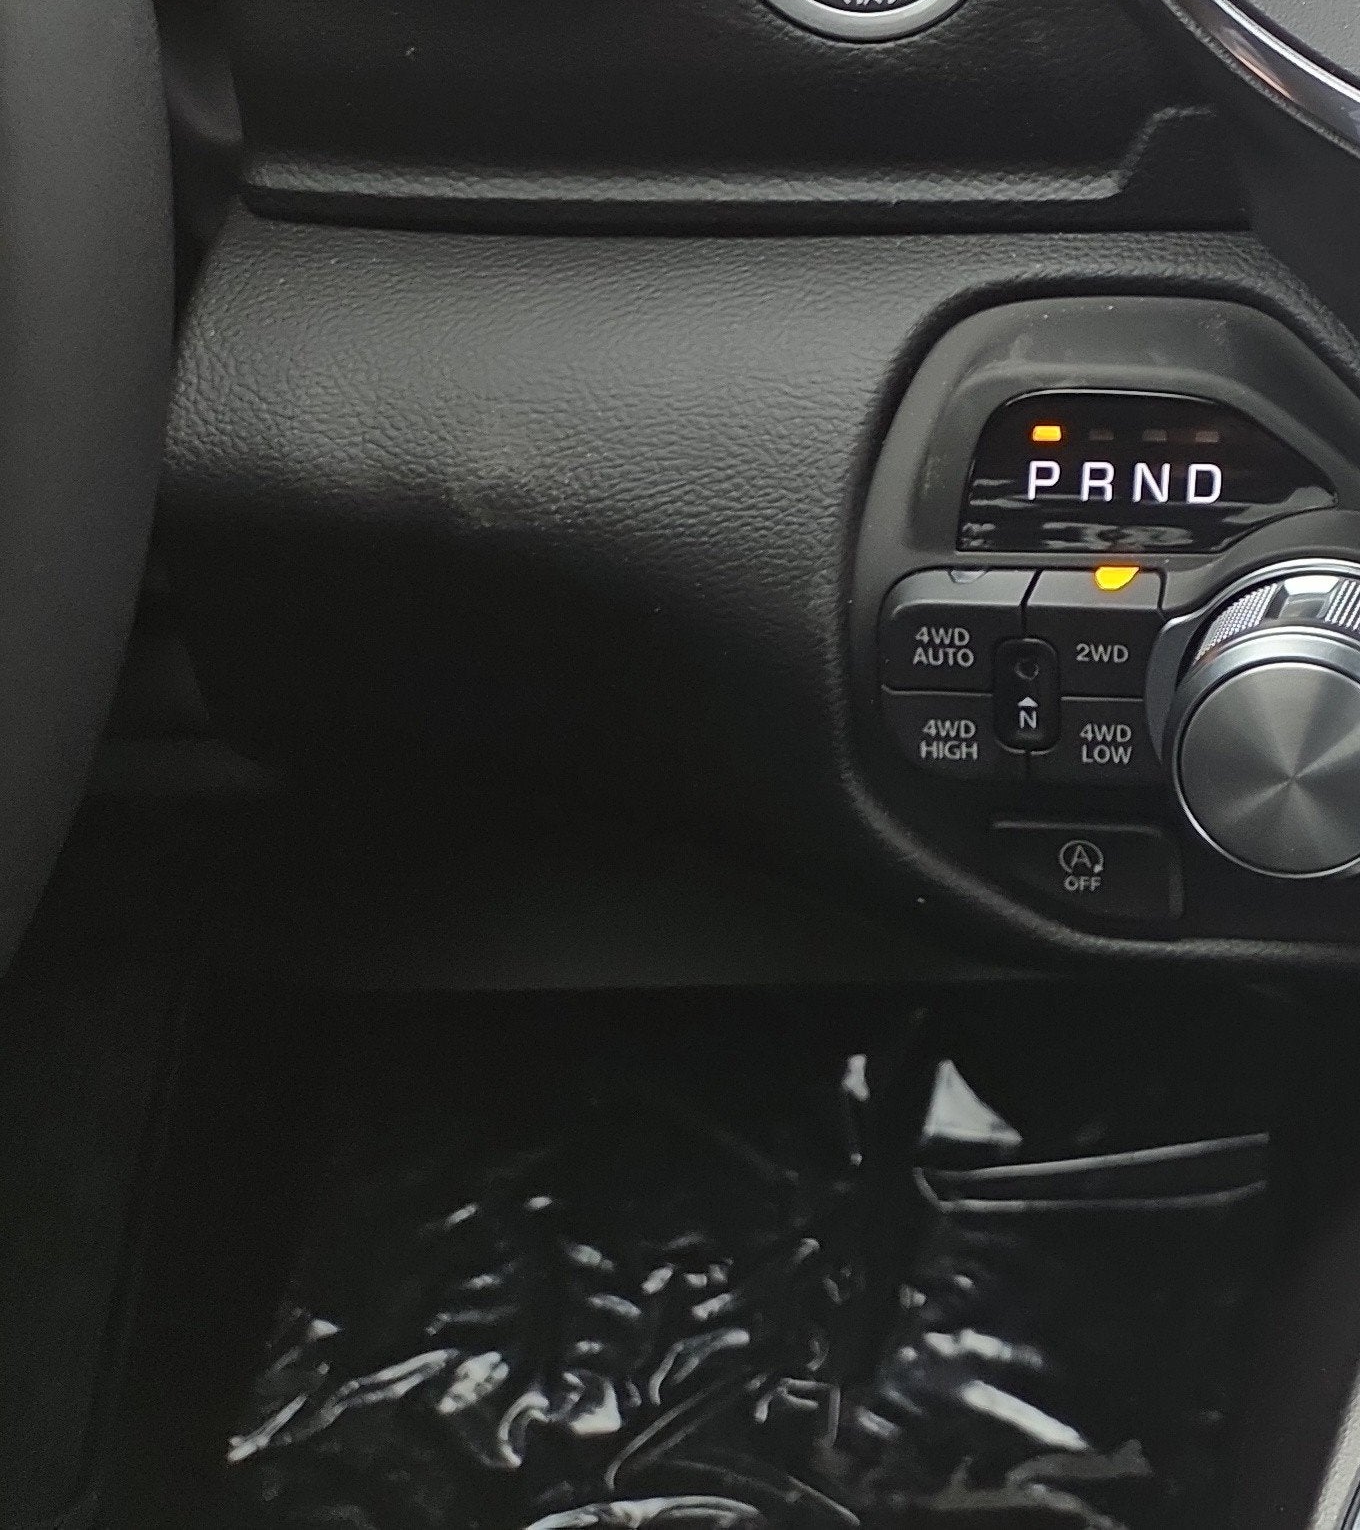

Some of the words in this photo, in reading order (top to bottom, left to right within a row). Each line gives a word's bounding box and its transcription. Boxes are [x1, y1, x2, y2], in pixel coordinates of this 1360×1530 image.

[915, 626, 971, 647] 4WD
[912, 646, 975, 668] AUTO
[1075, 642, 1130, 664] 2WD
[922, 719, 977, 739] 4WD
[1018, 709, 1038, 730] N
[1078, 723, 1133, 743] 4WD
[919, 740, 979, 761] HIGH
[1081, 744, 1133, 765] LOW
[1063, 875, 1102, 892] OFF
